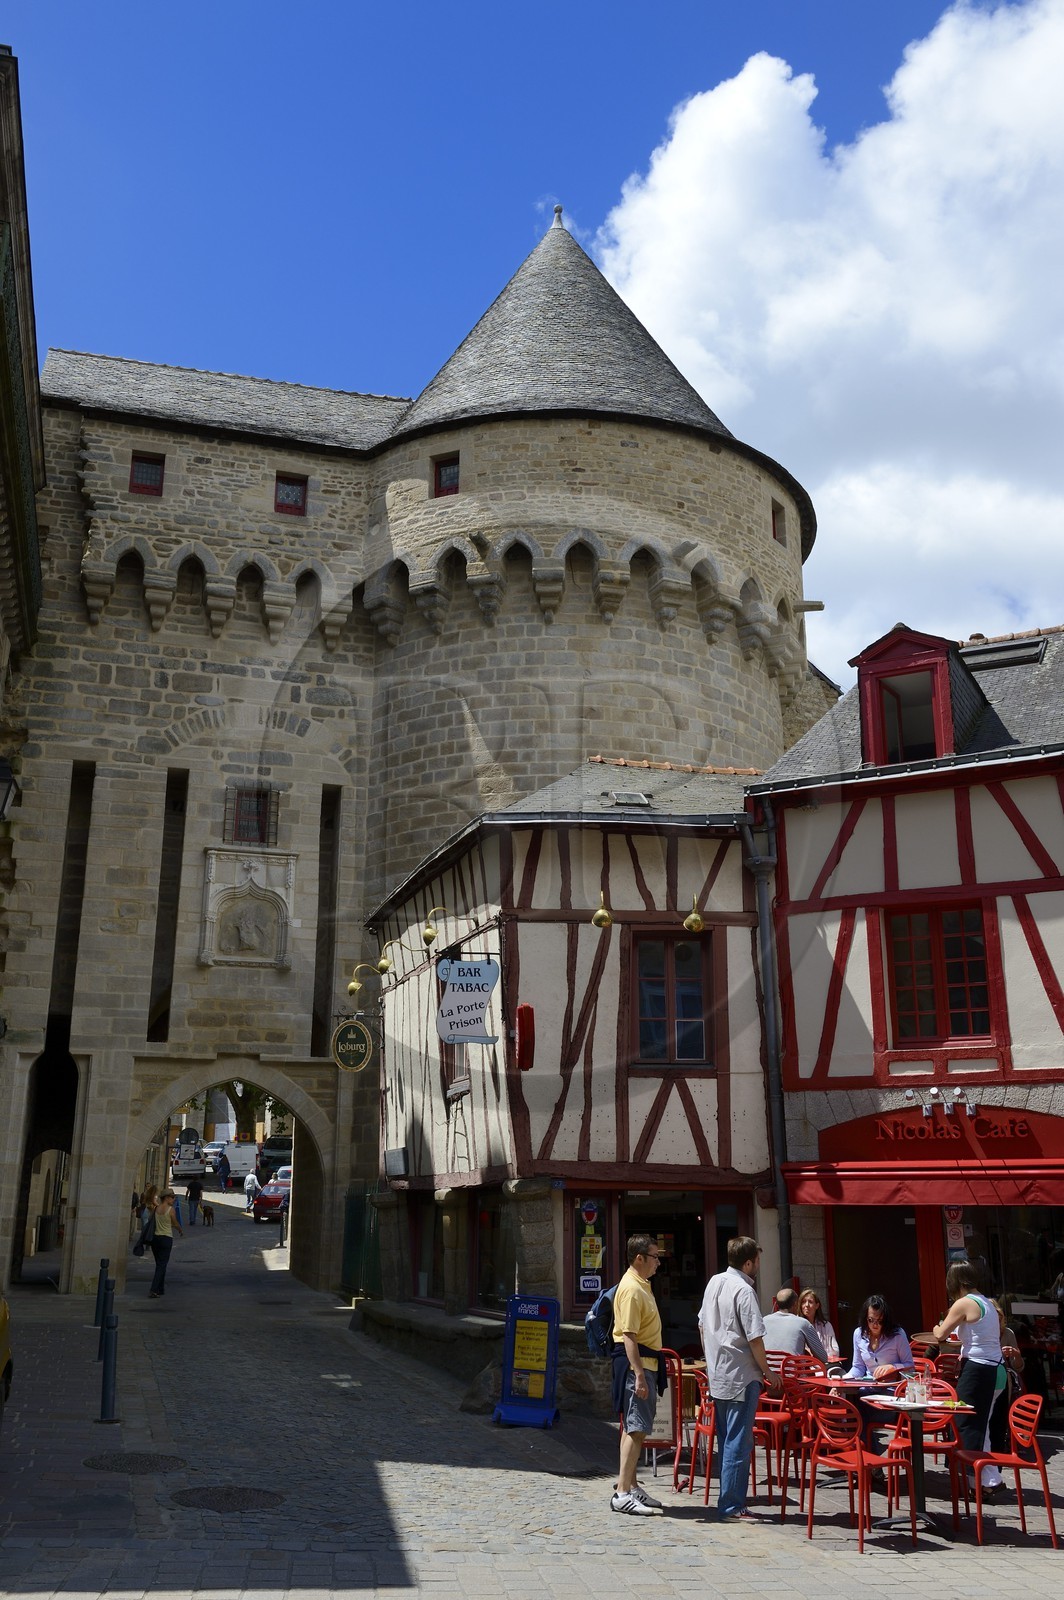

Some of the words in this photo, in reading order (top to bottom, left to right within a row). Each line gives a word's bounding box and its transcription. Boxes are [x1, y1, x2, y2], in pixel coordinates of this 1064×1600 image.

[457, 967, 482, 978] BAR
[449, 982, 490, 993] TABAC
[440, 1008, 454, 1018] La
[456, 1001, 486, 1015] Porte
[448, 1016, 483, 1031] Prison
[338, 1041, 366, 1053] Loburg
[874, 1118, 961, 1141] Nicolas
[971, 1115, 1029, 1140] Café
[518, 1306, 539, 1316] france
